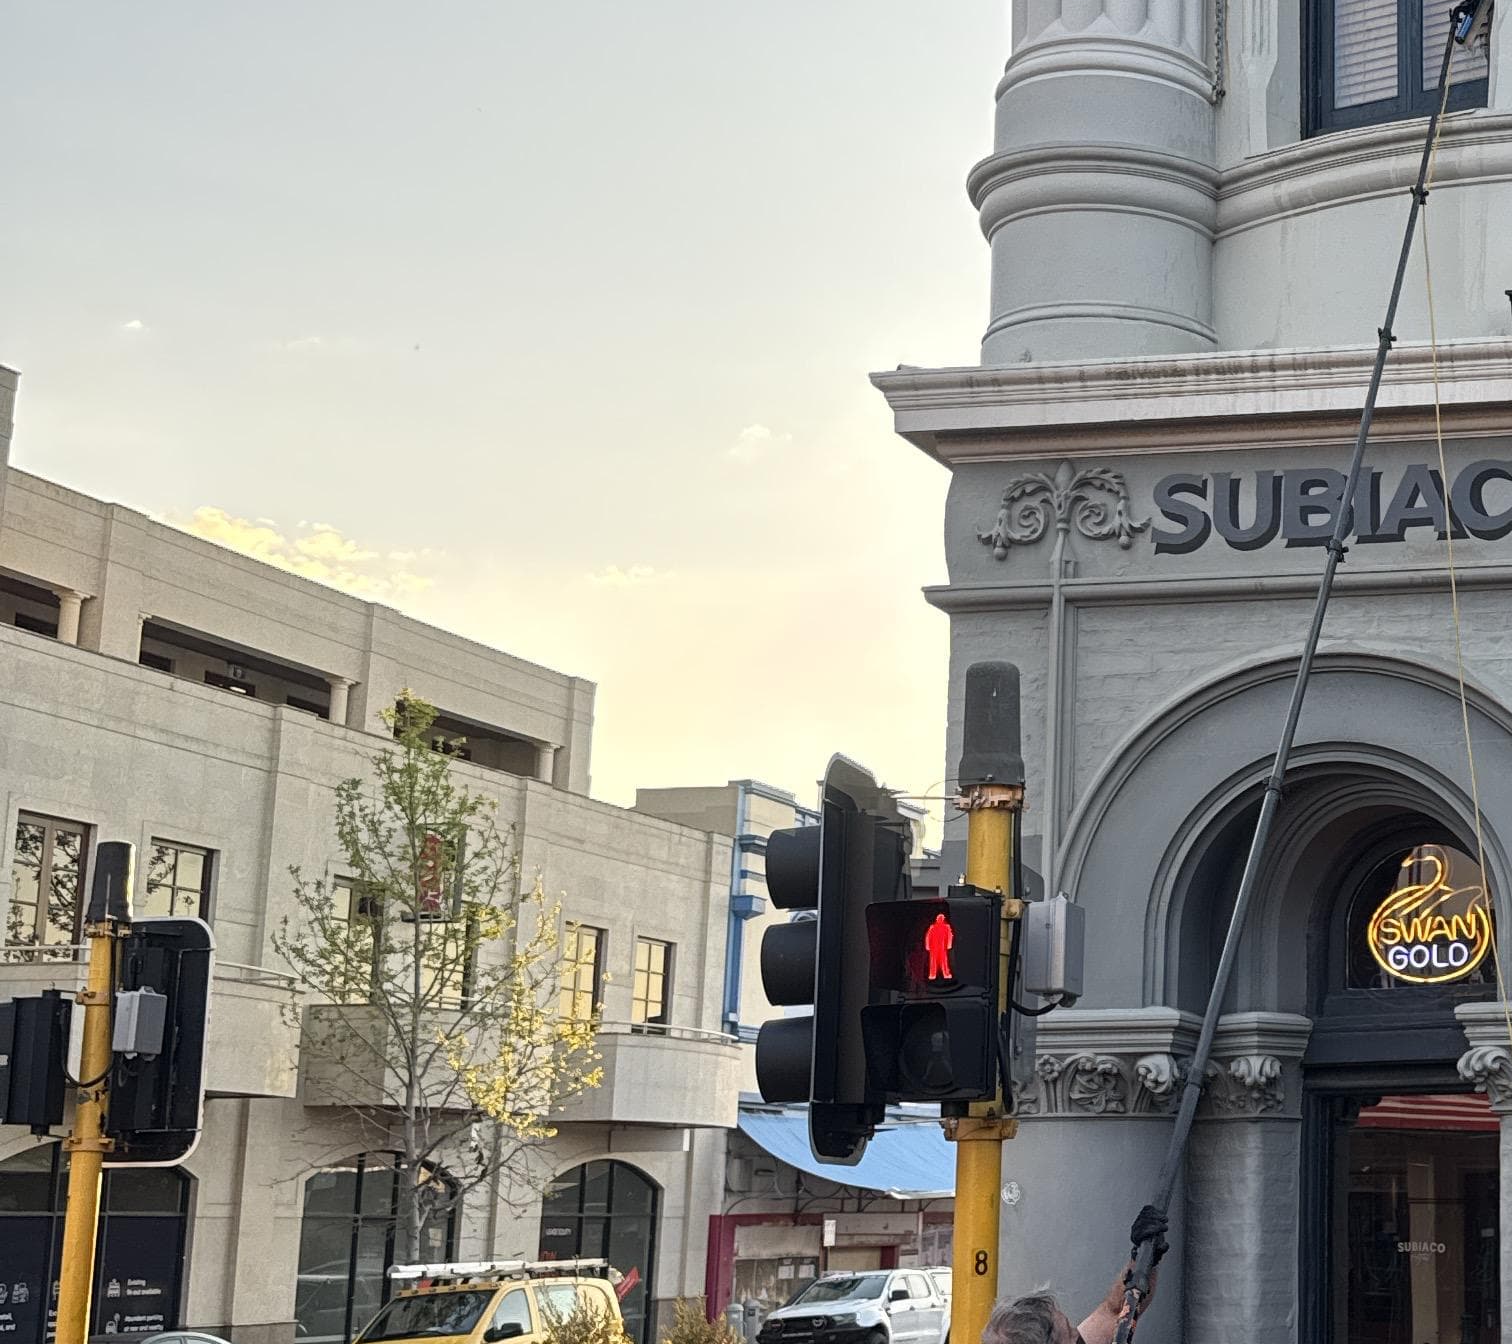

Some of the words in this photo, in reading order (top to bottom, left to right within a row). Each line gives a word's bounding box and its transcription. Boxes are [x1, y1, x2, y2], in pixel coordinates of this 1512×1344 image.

[1380, 914, 1477, 945] SWAN
[1388, 942, 1469, 971] GOLD
[1397, 1241, 1446, 1254] SUBIACO
[975, 1249, 988, 1276] 8
